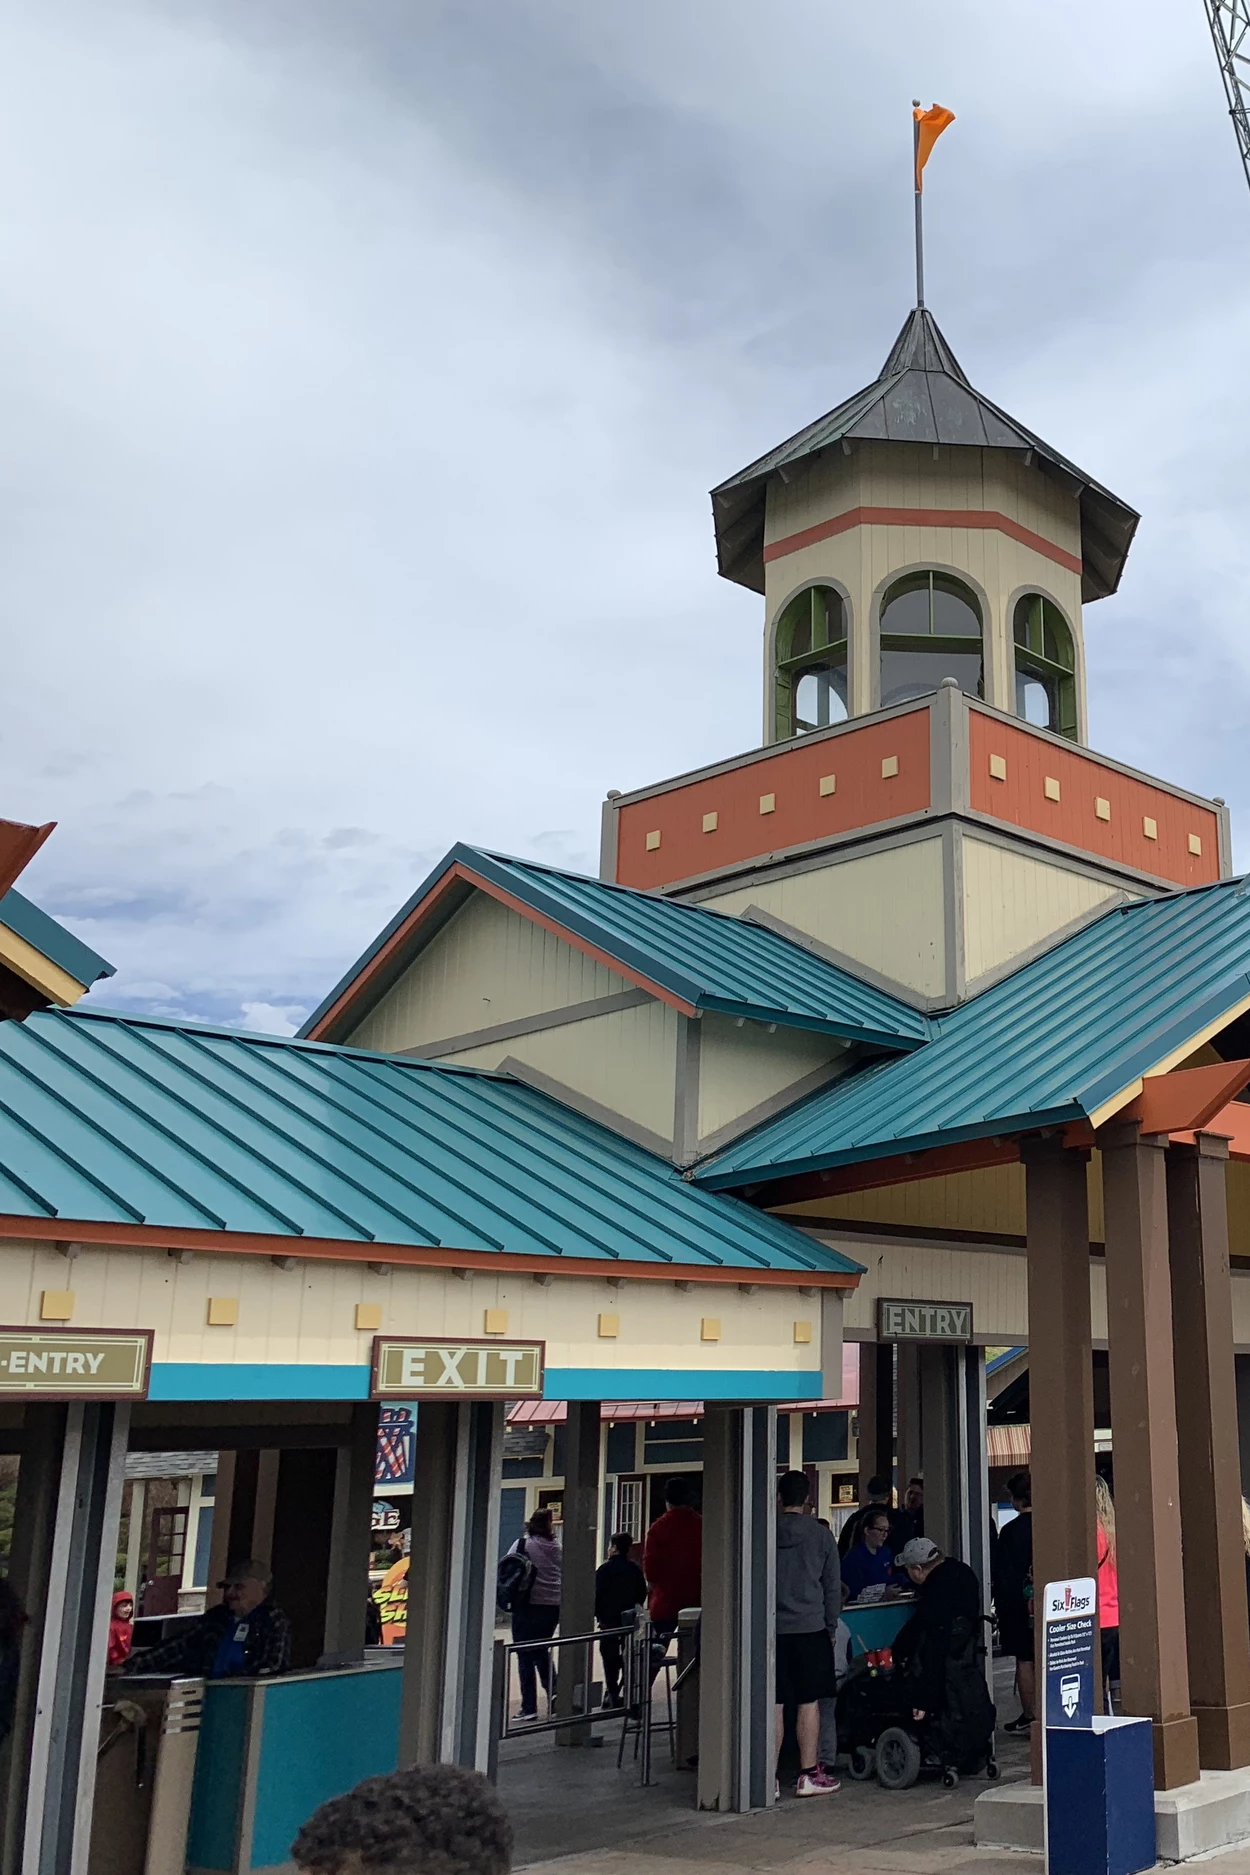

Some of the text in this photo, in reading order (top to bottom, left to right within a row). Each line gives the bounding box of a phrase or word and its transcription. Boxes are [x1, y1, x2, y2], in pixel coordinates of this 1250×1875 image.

[889, 1307, 967, 1334] ENTRY
[1, 1351, 105, 1374] -ENTRY
[401, 1350, 523, 1387] EXIT
[1052, 1596, 1090, 1611] Six Flags
[1049, 1619, 1092, 1634] Cooler Size Check
